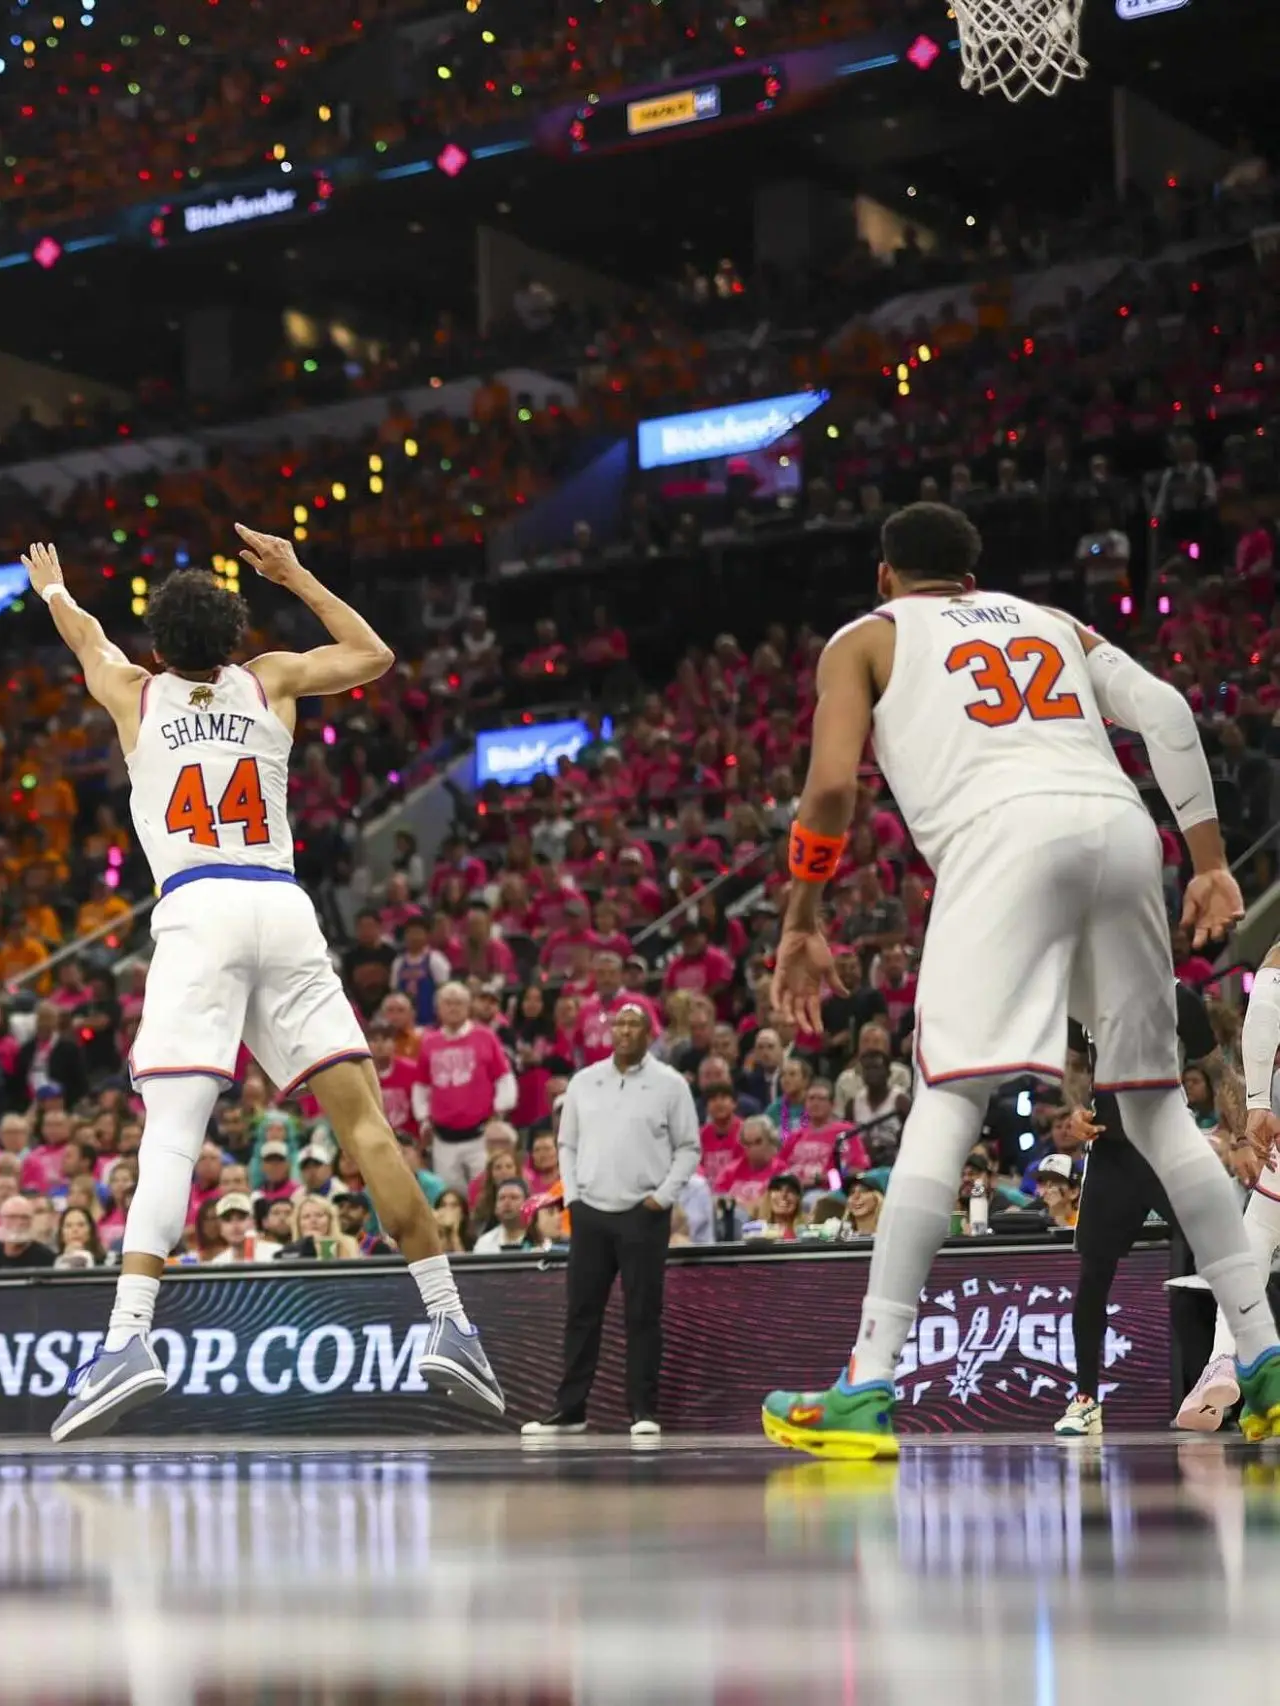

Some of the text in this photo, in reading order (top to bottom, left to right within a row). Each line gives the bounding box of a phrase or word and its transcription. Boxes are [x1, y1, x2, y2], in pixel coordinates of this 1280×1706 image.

[941, 606, 1020, 627] TOWNS
[944, 636, 1085, 728] 32
[161, 712, 256, 750] SHAMET
[165, 756, 270, 848] 44
[793, 835, 833, 874] 32
